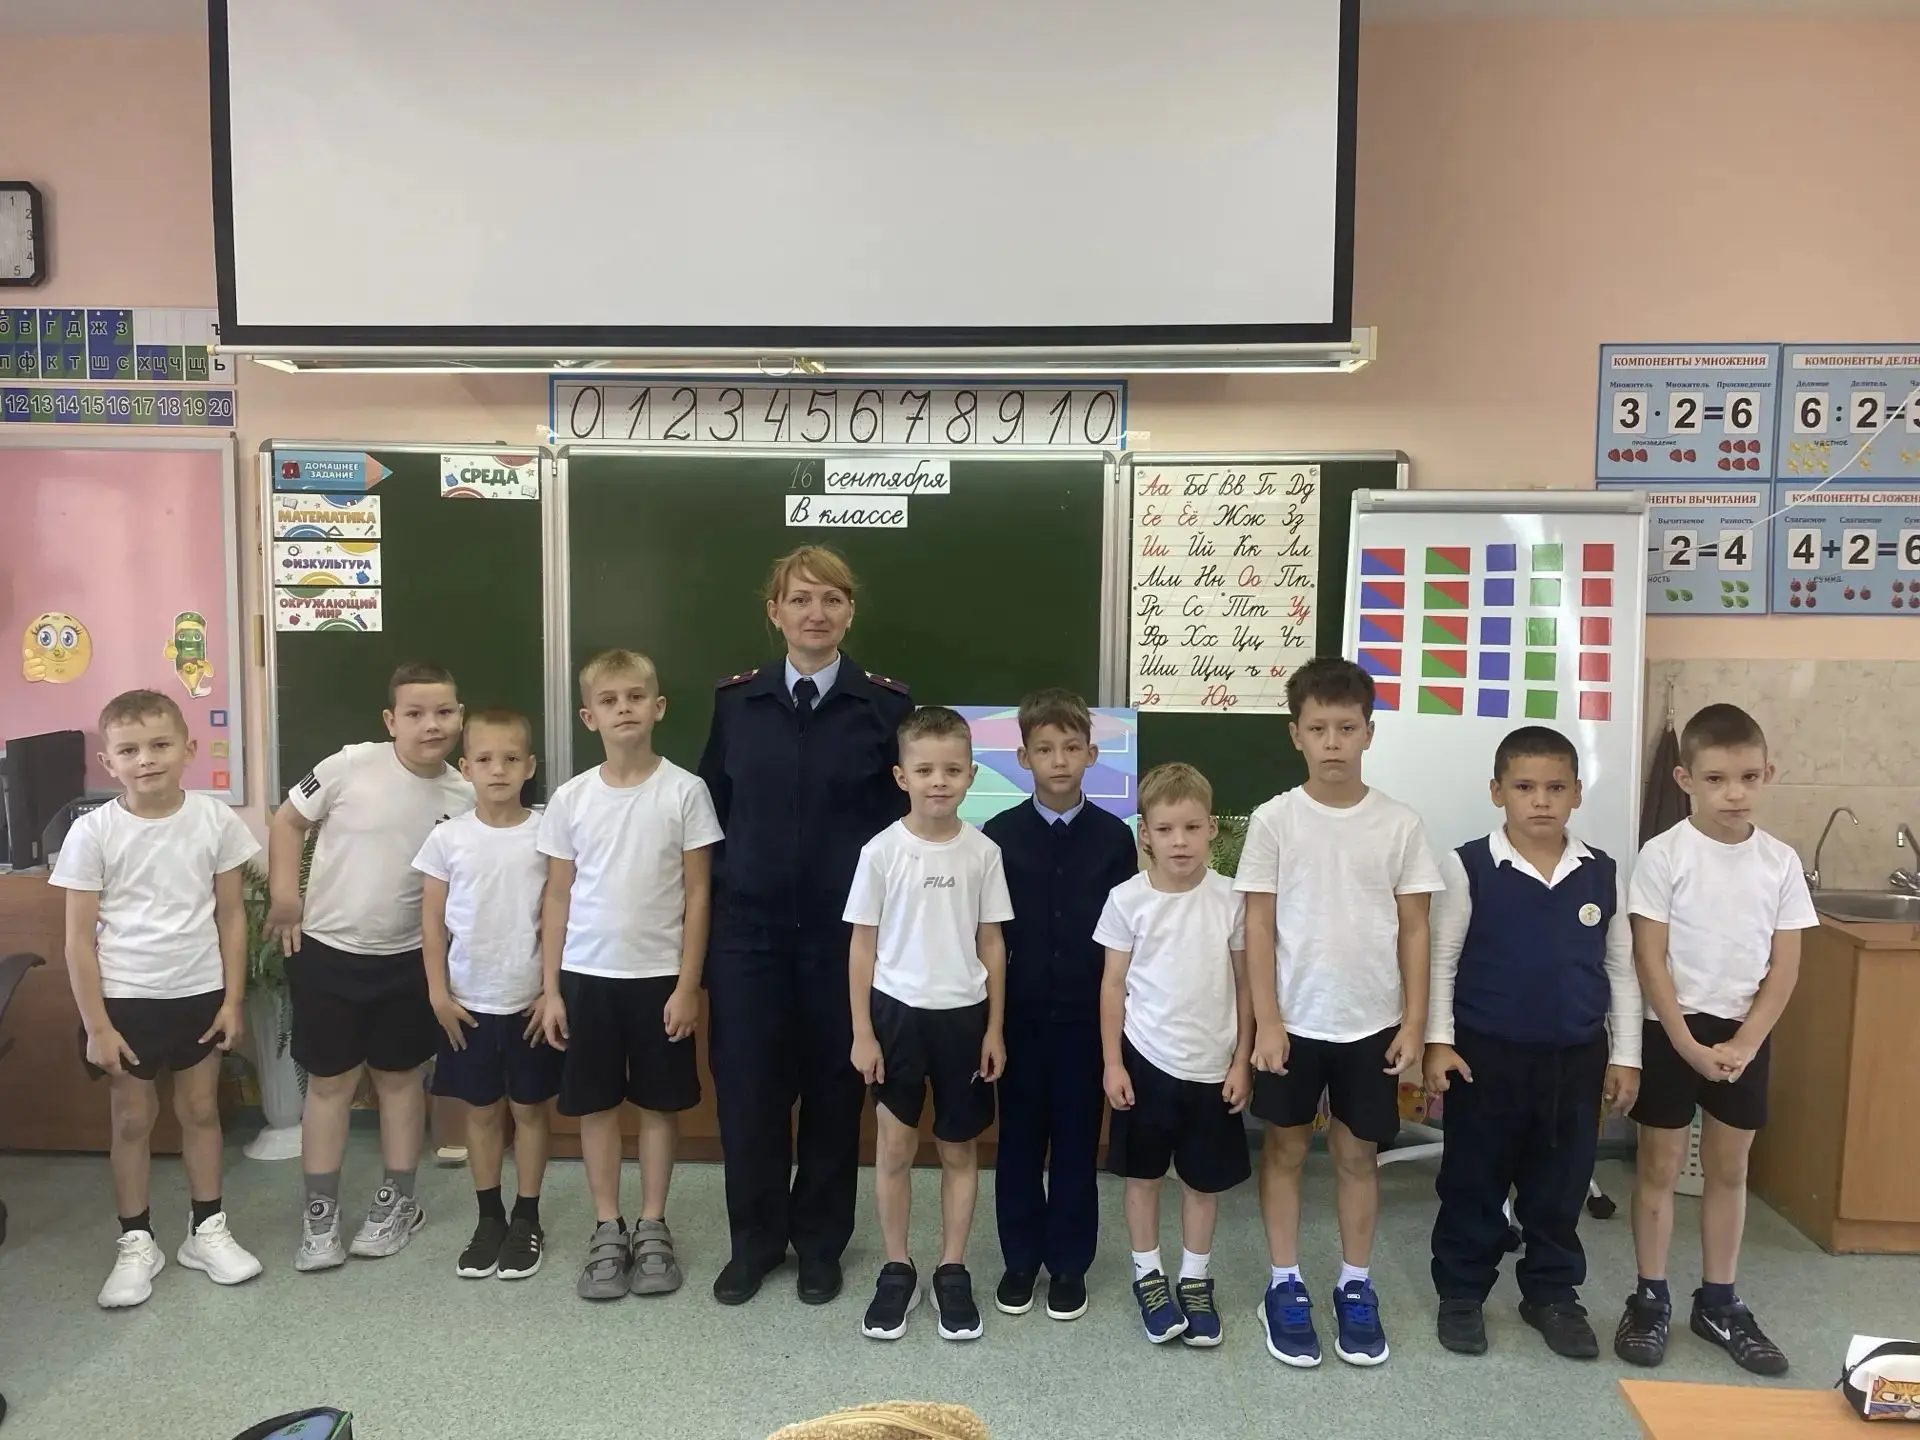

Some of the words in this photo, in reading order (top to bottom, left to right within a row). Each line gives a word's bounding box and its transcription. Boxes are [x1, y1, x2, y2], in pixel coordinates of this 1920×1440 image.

[46, 321, 55, 335] г
[67, 321, 81, 337] д
[1613, 356, 1692, 366] КОМПОНЕНТЫ
[1695, 357, 1766, 367] УМНОЖЕНИЯ
[1805, 356, 1883, 366] КОМПОНЕНТЫ
[1609, 381, 1653, 389] Множитель
[1665, 381, 1709, 389] Множитель
[1716, 381, 1772, 390] Произведение
[6, 395, 29, 413] 12
[31, 395, 54, 413] 13
[56, 396, 79, 414] 14
[82, 396, 105, 414] 15
[107, 396, 131, 415] 16
[132, 397, 155, 415] 17
[158, 397, 181, 416] 18
[184, 398, 207, 416] 19
[209, 398, 232, 416] 20
[571, 386, 601, 439] 0
[629, 386, 650, 440] 1
[664, 388, 697, 440] 2
[709, 388, 743, 441] 3
[764, 389, 789, 442] 4
[801, 389, 837, 442] 5
[850, 389, 882, 443] 6
[900, 390, 931, 443] 7
[946, 390, 977, 444] 8
[992, 390, 1024, 444] 9
[1619, 397, 1640, 429] 3
[304, 462, 359, 471] ДОМАШНЕЕ
[310, 470, 354, 480] ЗАДАНИЕ
[460, 468, 519, 486] СРЕДА
[788, 460, 816, 489] 16
[827, 460, 948, 494] сентября
[1138, 474, 1173, 496] Аа
[1183, 473, 1219, 496] Бб
[1218, 473, 1246, 496] Вв
[1253, 472, 1278, 496] Гг
[1285, 473, 1315, 504] Дд
[1688, 495, 1757, 504] ВЫЧИТАНИЯ
[278, 510, 377, 524] МАТЕМАТИКА
[790, 495, 811, 523] В
[819, 508, 905, 525] классе
[1141, 504, 1162, 526] Ее
[1178, 501, 1198, 526] Ёё
[1213, 504, 1266, 526] Жж
[1281, 503, 1304, 534] Зз
[1142, 534, 1170, 556] Ии
[1187, 531, 1216, 556] Йй
[1233, 534, 1262, 556] Кк
[1277, 534, 1311, 556] Лл
[282, 559, 372, 570] ФИЗКУЛЬТУРА
[1137, 565, 1182, 587] Мм
[1194, 564, 1225, 587] Нн
[1237, 565, 1262, 587] Оо
[1274, 564, 1310, 587] Пп
[279, 597, 377, 610] ОКРУЖАЮЩИЙ
[1137, 594, 1164, 625] Рр
[1182, 595, 1204, 617] Сс
[1222, 595, 1269, 617] Тт
[1287, 595, 1310, 625] Уу
[315, 609, 342, 619] МИР
[1138, 625, 1168, 654] Фф
[1180, 624, 1219, 646] Хх
[1231, 625, 1264, 652] Цц
[1280, 625, 1305, 647] Чч
[1139, 654, 1179, 676] Шш
[1190, 654, 1235, 681] Щщ
[1269, 665, 1287, 677] ы
[1138, 684, 1160, 705] Ээ
[1201, 684, 1238, 706] Юю
[923, 876, 956, 888] FILA
